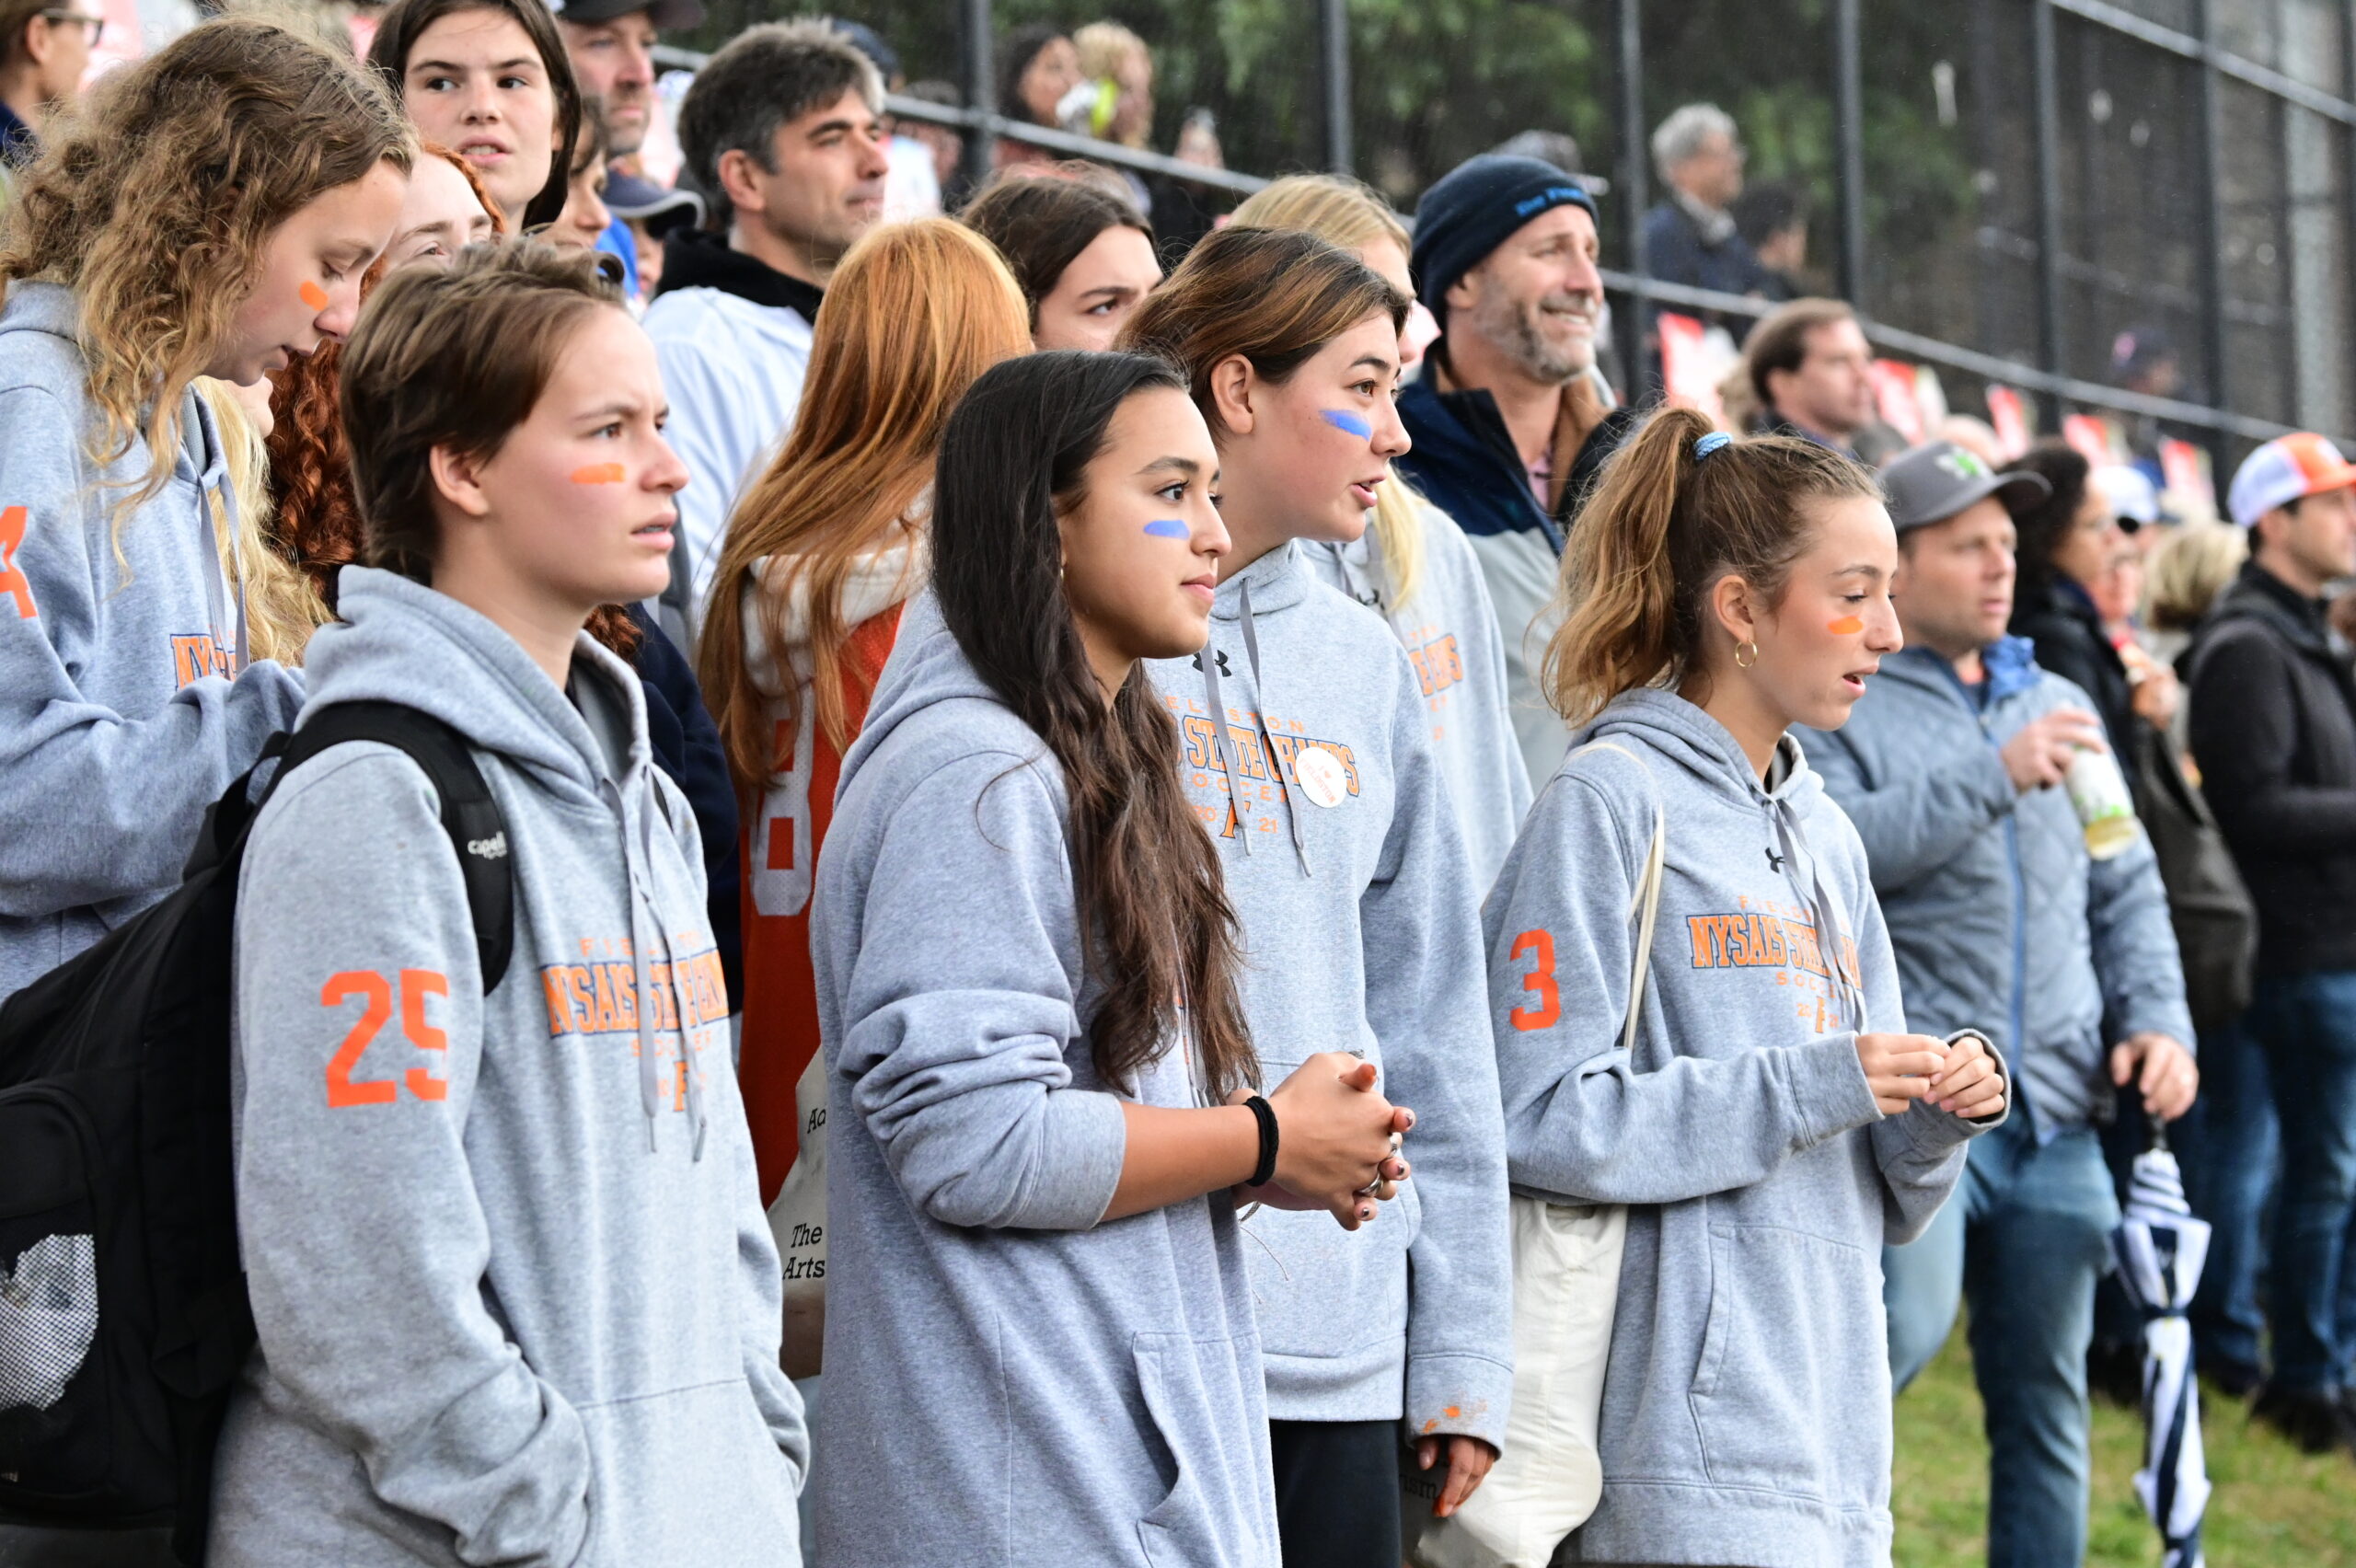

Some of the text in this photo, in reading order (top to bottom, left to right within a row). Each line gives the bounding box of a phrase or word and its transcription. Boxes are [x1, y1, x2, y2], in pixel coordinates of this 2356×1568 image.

[1258, 816, 1277, 833] 21
[1686, 913, 1788, 968] NYSAIS
[1509, 928, 1562, 1032] 3
[320, 969, 448, 1108] 25
[791, 1223, 824, 1249] The
[782, 1256, 826, 1280] Arts
